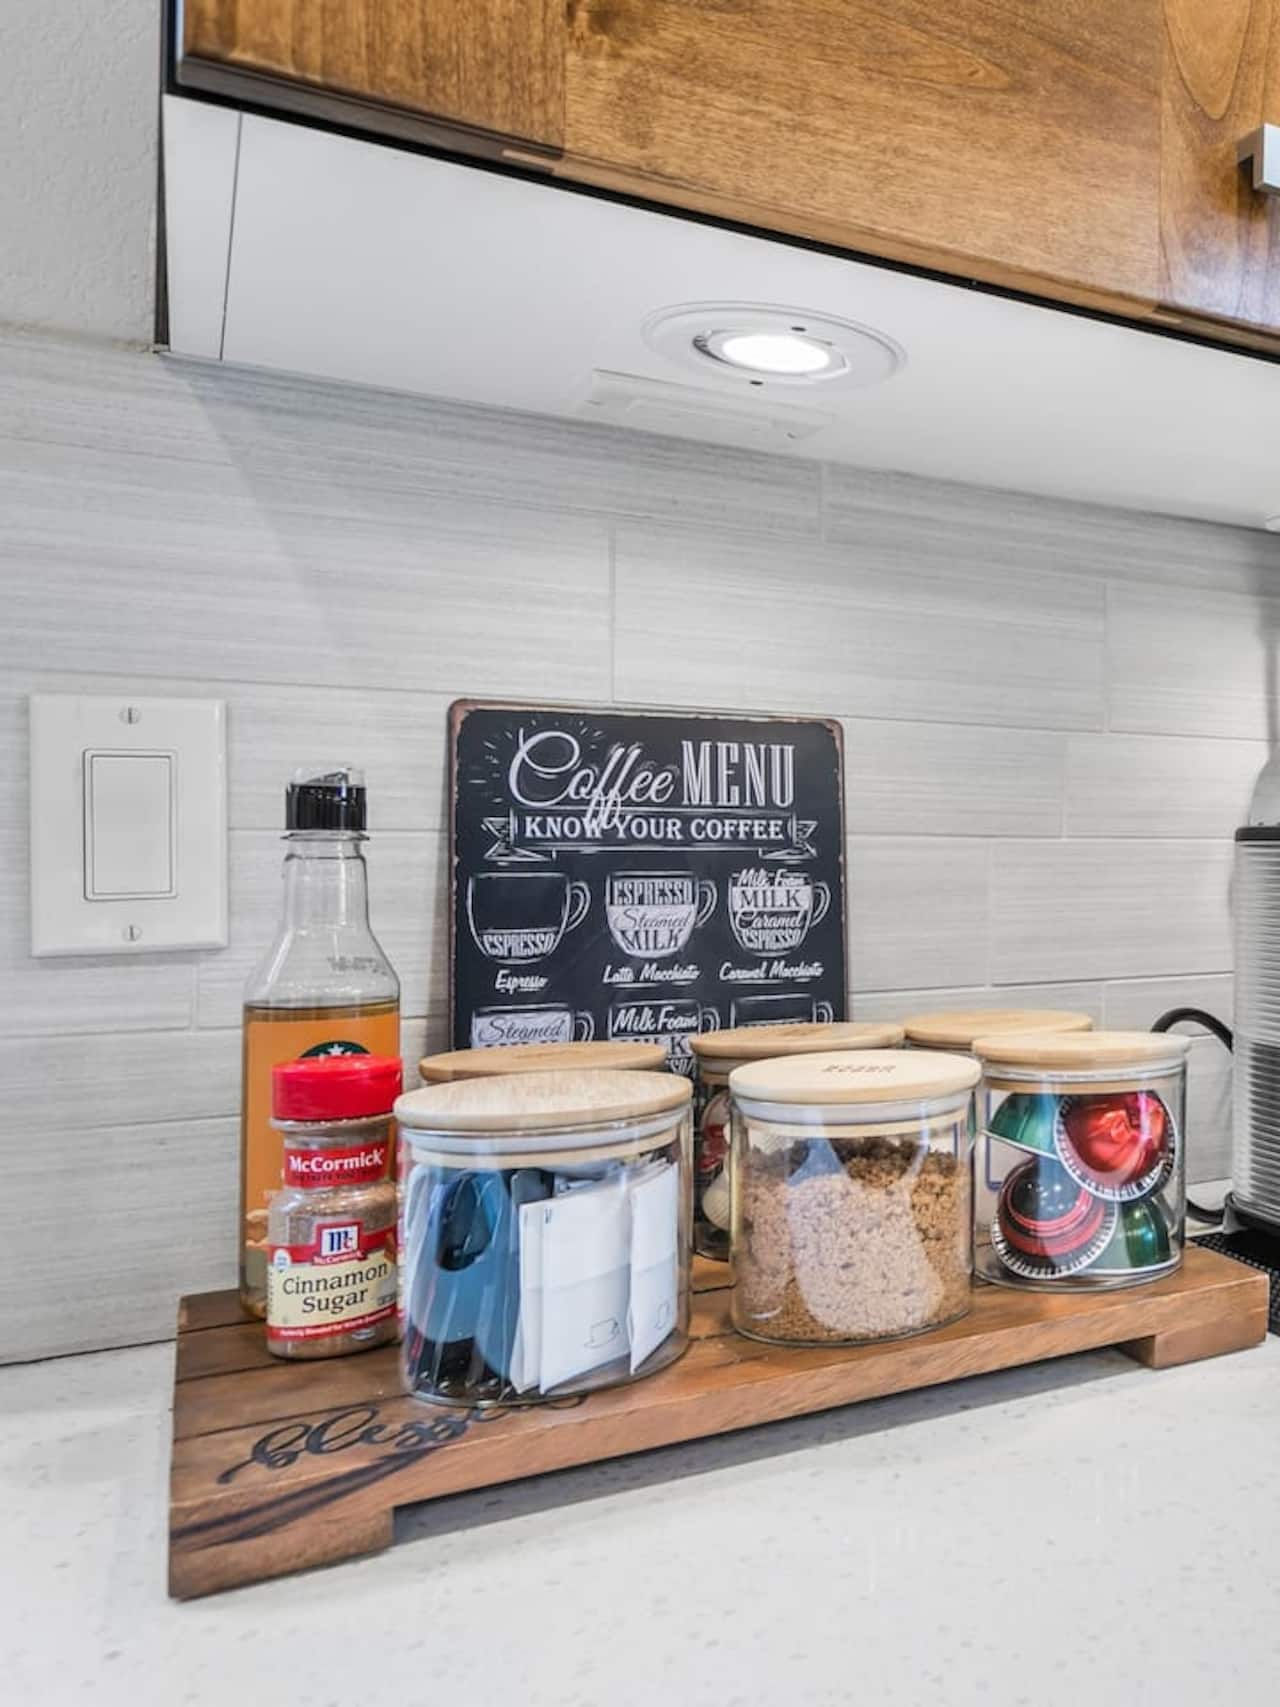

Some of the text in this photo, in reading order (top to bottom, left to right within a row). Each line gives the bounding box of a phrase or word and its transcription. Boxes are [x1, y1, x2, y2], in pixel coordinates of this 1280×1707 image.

[509, 728, 797, 830] Coffee MENU
[525, 815, 785, 841] KNOW YOUR COFFEE
[612, 878, 694, 905] ESPRESSO
[740, 888, 802, 908] MILK
[613, 907, 691, 930] Steamed
[735, 908, 805, 929] Caramel
[482, 931, 556, 960] ESPRESSO
[620, 928, 685, 955] MILK
[740, 928, 802, 951] ESPRESSO
[495, 970, 549, 994] Espresso
[602, 965, 635, 984] Latte
[719, 962, 767, 981] Caramel
[478, 1016, 566, 1042] Steamed
[612, 1005, 699, 1033] Milk Foam
[288, 1147, 383, 1173] McCormick
[282, 1262, 389, 1296] Cinnamon
[301, 1287, 369, 1315] Sugar
